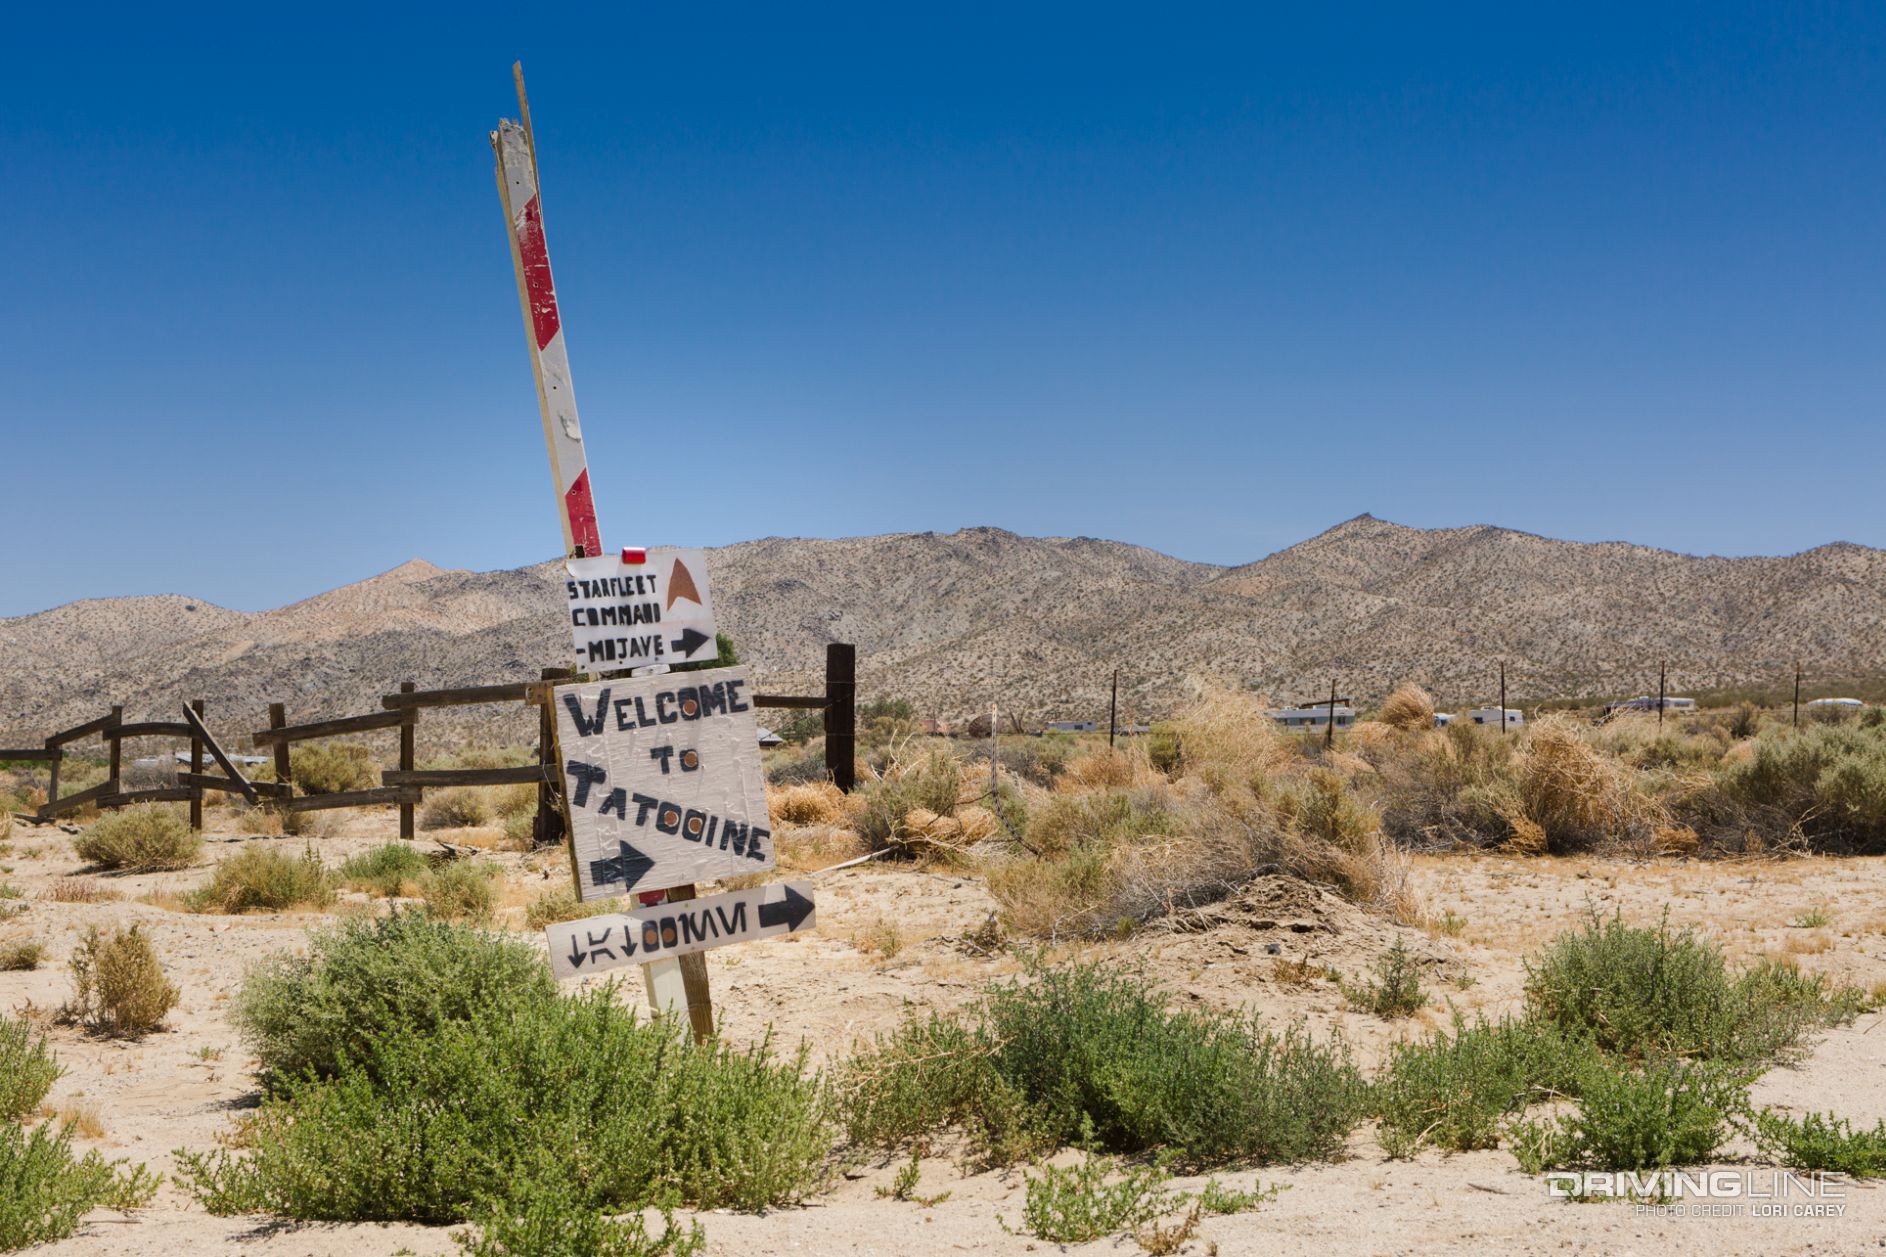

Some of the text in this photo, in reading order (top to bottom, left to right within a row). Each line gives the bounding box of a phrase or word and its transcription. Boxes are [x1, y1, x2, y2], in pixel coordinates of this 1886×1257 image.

[567, 575, 657, 600] STARFLEET
[572, 602, 661, 627] COMMAND
[563, 679, 749, 737] WELCOME
[650, 745, 699, 775] TO
[566, 759, 771, 862] TATOOINE
